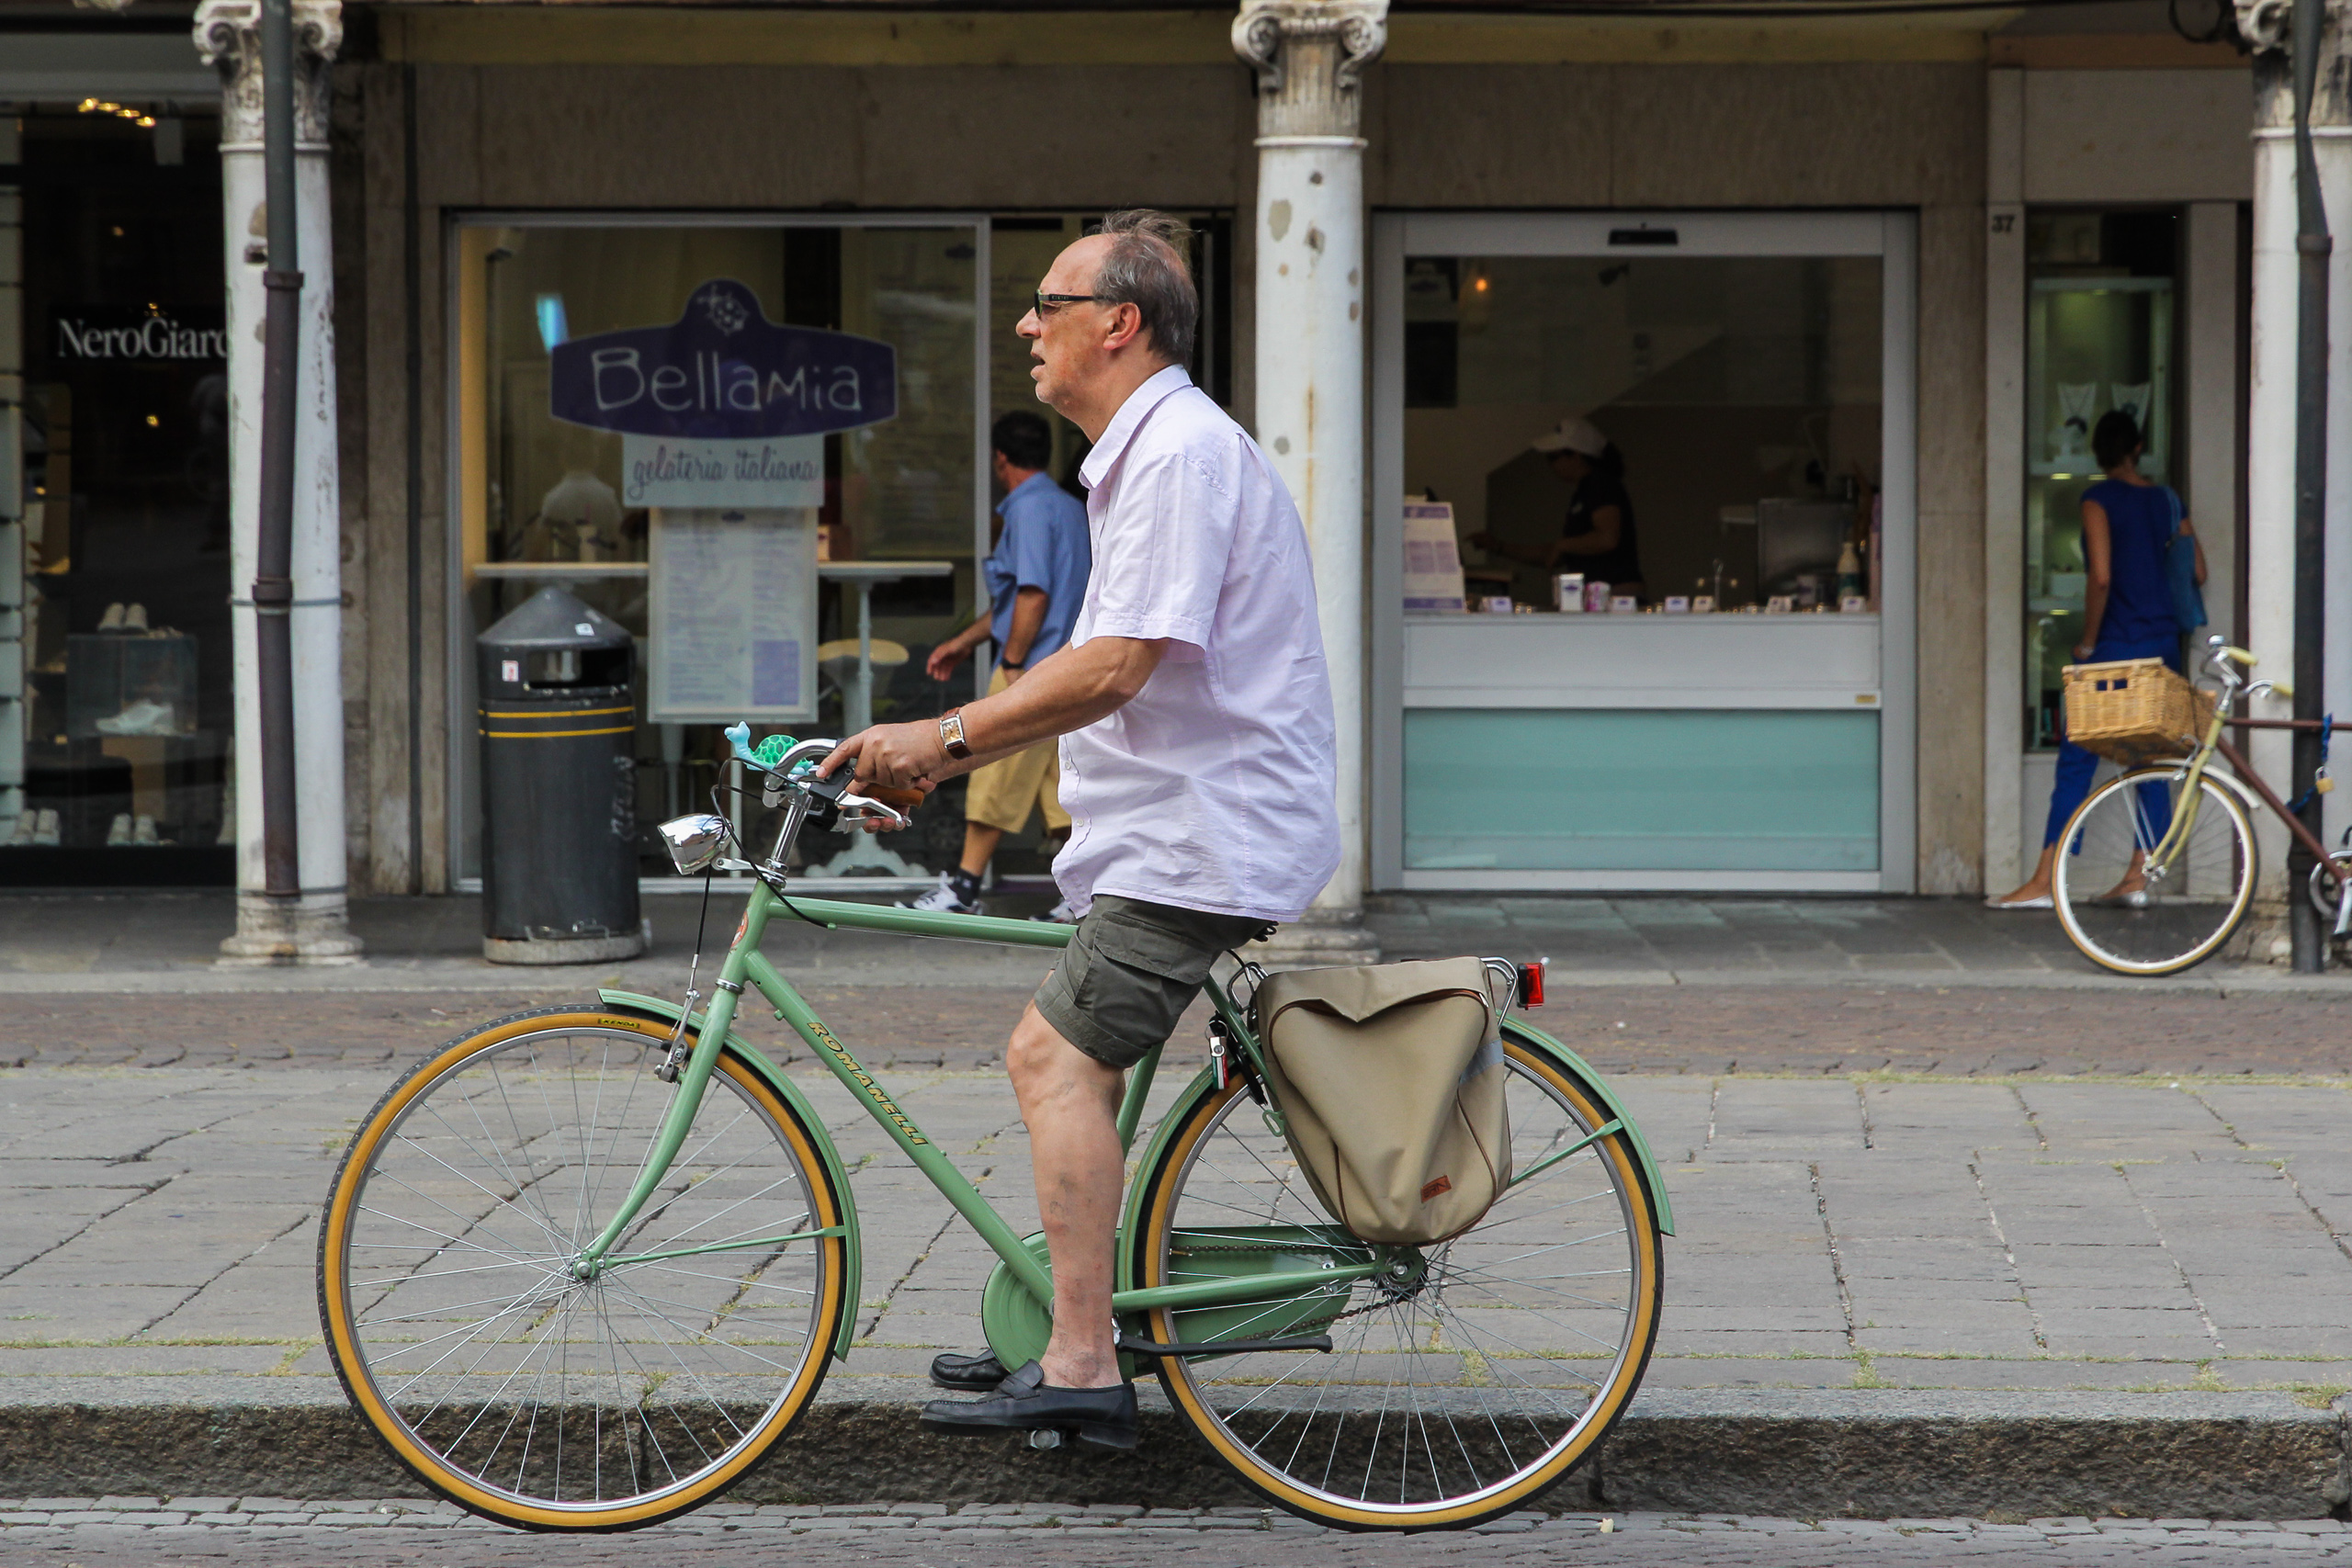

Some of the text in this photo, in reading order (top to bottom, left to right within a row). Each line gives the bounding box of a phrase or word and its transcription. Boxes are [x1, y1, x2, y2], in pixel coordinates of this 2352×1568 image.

[1991, 213, 2017, 233] 37
[628, 445, 818, 501] gelateria italiana
[603, 1019, 636, 1028] KENDA
[808, 1021, 929, 1145] ROMANELLI
